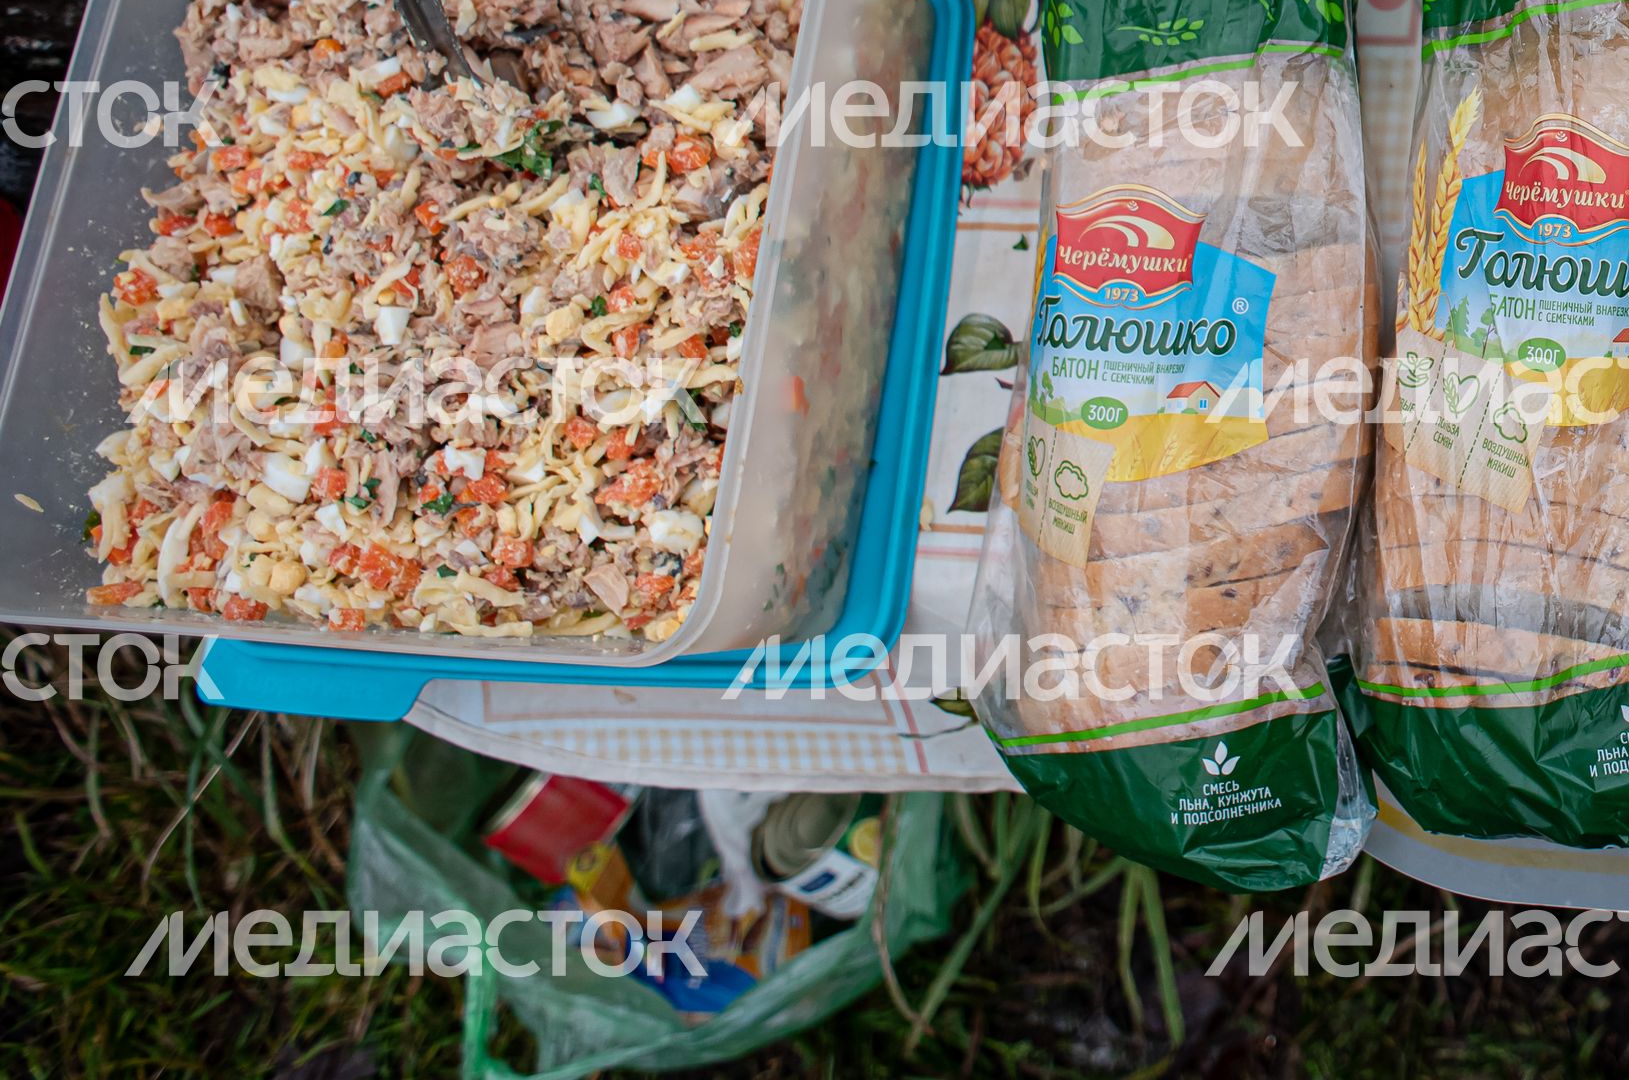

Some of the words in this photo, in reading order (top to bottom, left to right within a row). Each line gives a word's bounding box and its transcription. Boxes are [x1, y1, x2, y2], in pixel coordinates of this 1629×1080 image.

[1505, 181, 1626, 210] Черёмушки
[1538, 223, 1572, 238] 1973
[1058, 244, 1188, 274] Черёмушки
[1104, 287, 1140, 303] 1973
[1489, 294, 1536, 321] БАТОН
[1539, 300, 1593, 314] ПШЕНИЧНЫЙ
[1546, 313, 1595, 327] СЕМЕЧКАМИ
[1052, 356, 1100, 380] БАТОН
[1103, 360, 1155, 374] ПШЕНИЧНЫЙ
[1110, 372, 1155, 385] СЕМЕЧКАМИ
[1589, 764, 1598, 778] И
[1203, 780, 1240, 796] СМЕСЬ
[1178, 798, 1213, 811] ЛЬНА,
[1217, 786, 1272, 808] КУНЖУТА
[1170, 812, 1179, 825] И
[1183, 798, 1282, 825] ПОДСОЛНЕЧНИКА
